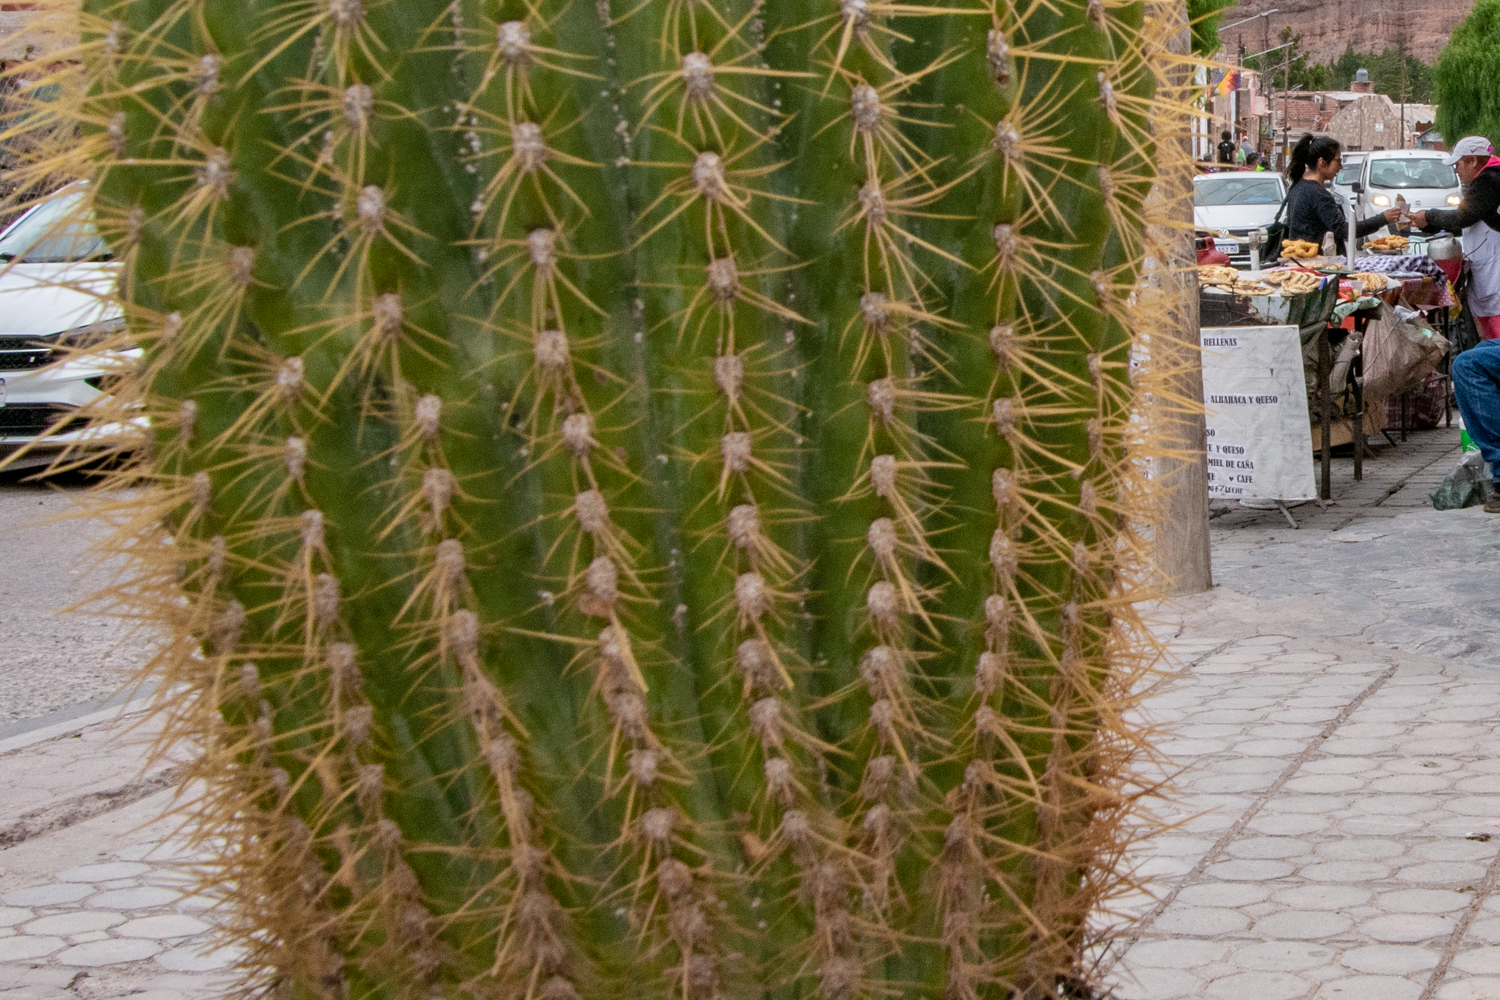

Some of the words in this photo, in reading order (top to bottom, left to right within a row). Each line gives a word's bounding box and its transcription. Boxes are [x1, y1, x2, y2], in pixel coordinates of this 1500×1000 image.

[1203, 338, 1237, 346] RELLENAS
[1211, 395, 1246, 404] ALBAHACA
[1255, 396, 1278, 404] QUESO
[1206, 429, 1215, 437] SO
[1216, 445, 1220, 453] Y
[1223, 446, 1245, 454] QUESO
[1207, 458, 1224, 467] MIEL
[1226, 460, 1235, 468] DE
[1237, 459, 1254, 469] CAÑA
[1237, 475, 1253, 483] CAFE
